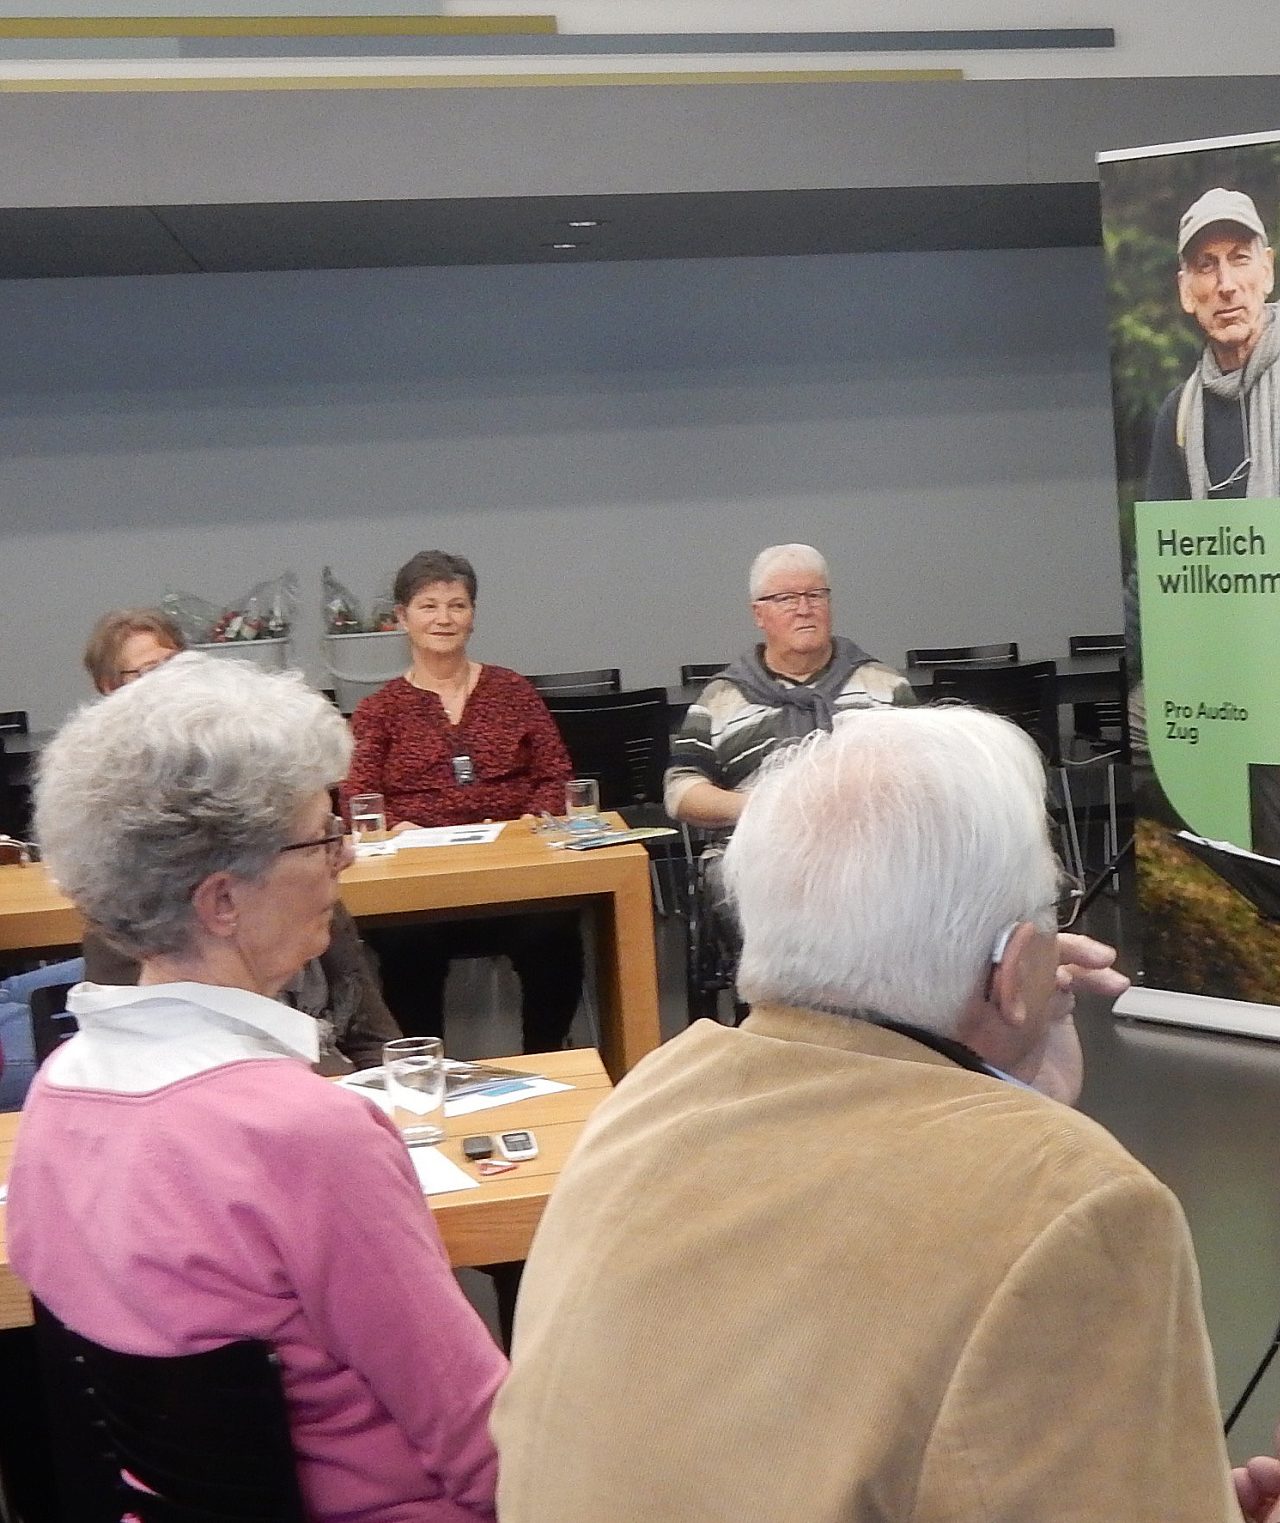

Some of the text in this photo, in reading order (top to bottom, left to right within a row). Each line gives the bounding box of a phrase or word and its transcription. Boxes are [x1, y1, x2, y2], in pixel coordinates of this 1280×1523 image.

[1157, 526, 1265, 556] Herzlich
[1164, 701, 1248, 721] Pro Audito
[1166, 722, 1199, 744] Zug
